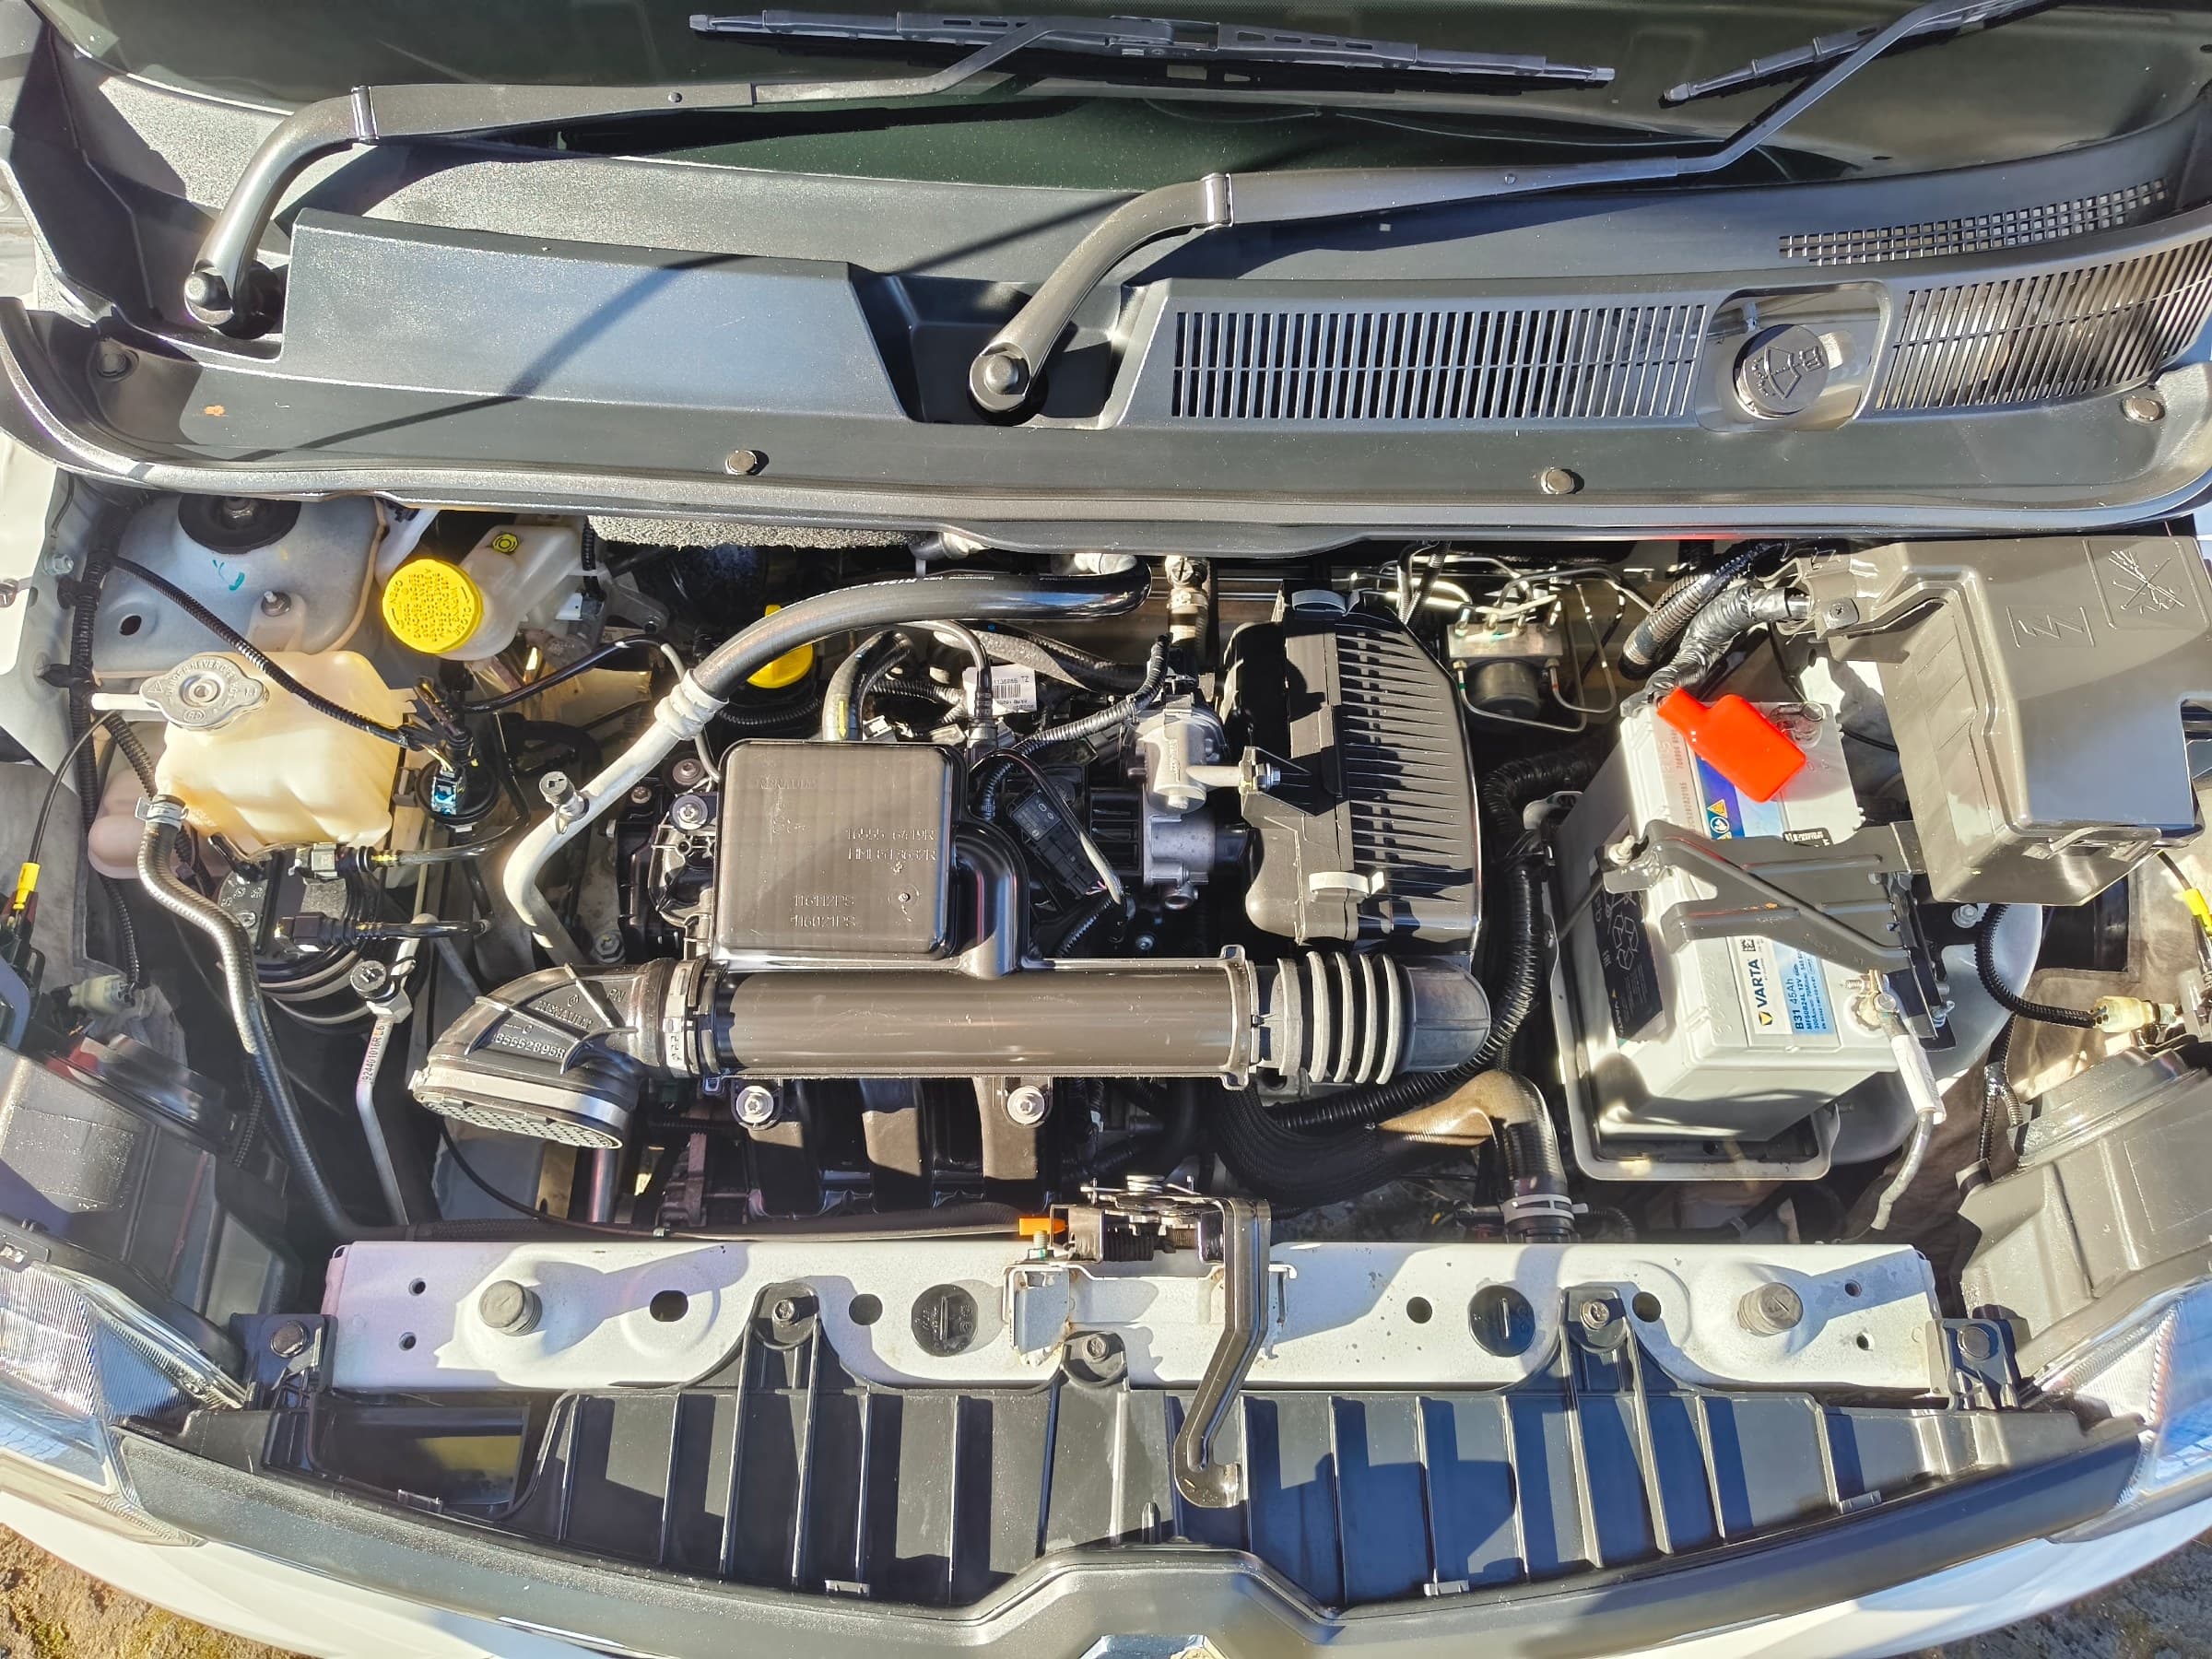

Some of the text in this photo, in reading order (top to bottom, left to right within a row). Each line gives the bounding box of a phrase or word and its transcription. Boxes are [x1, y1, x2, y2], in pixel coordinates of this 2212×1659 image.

[1747, 959, 1768, 1008] VARTA
[1785, 978, 1797, 1005] 45Ah
[1793, 1009, 1804, 1030] B31
